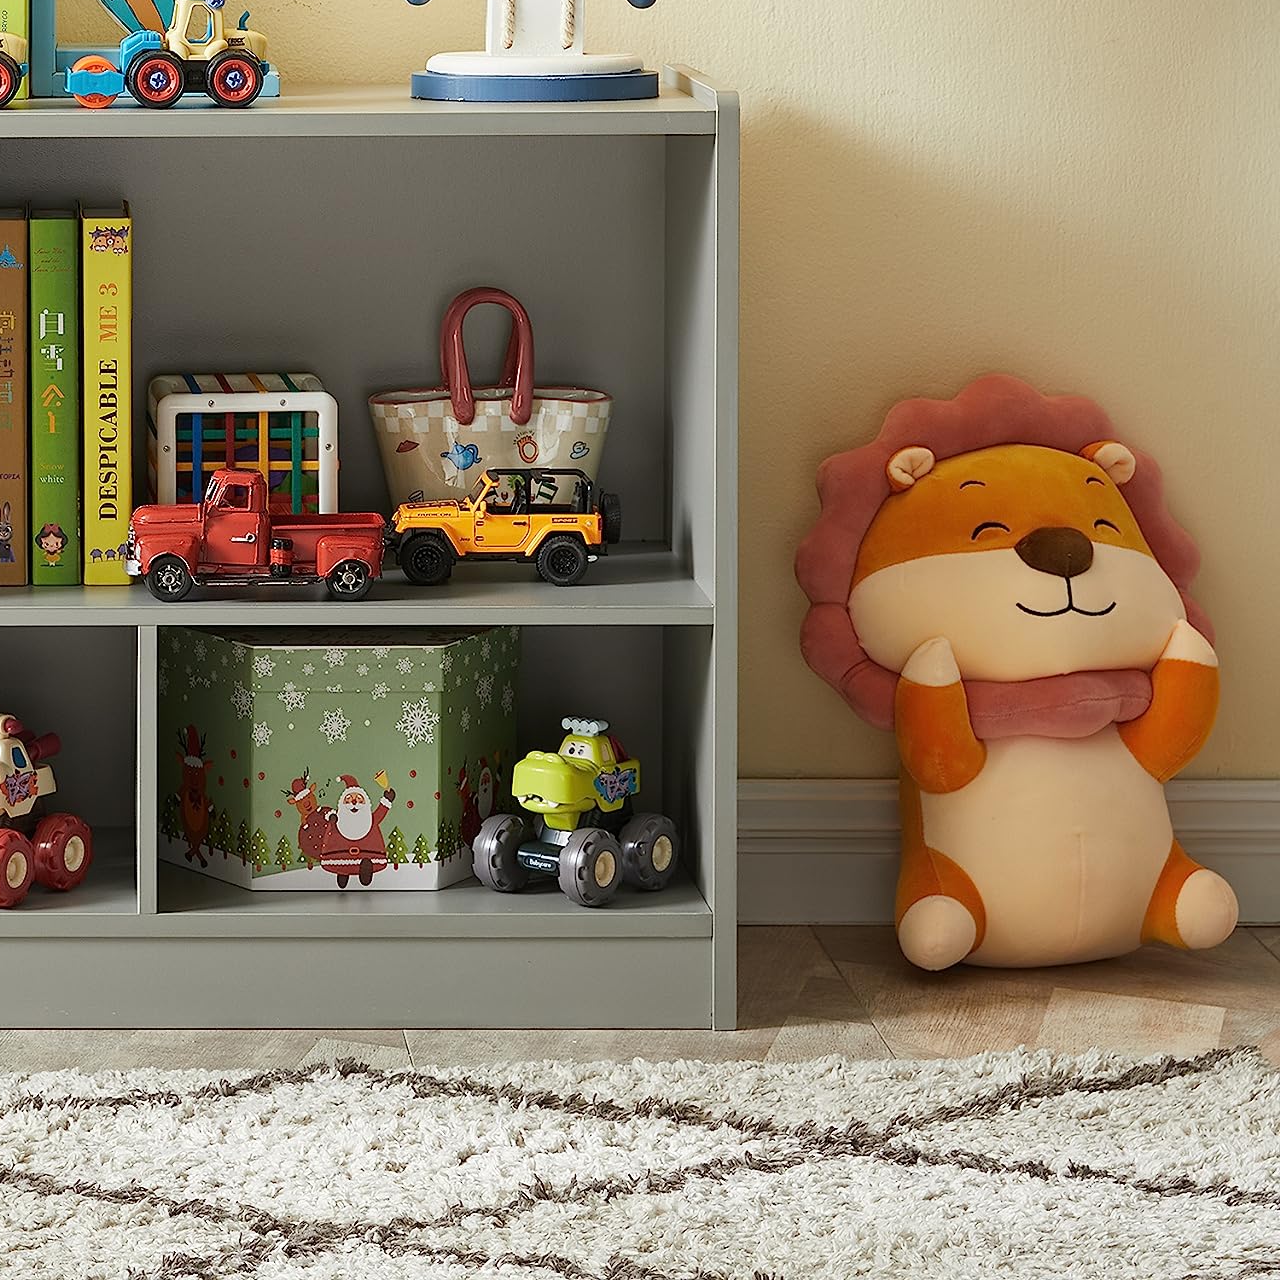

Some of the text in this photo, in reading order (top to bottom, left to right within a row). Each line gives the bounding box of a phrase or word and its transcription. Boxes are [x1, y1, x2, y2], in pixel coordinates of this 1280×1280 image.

[99, 282, 118, 521] DESPICABLE ME 3
[39, 474, 65, 483] white
